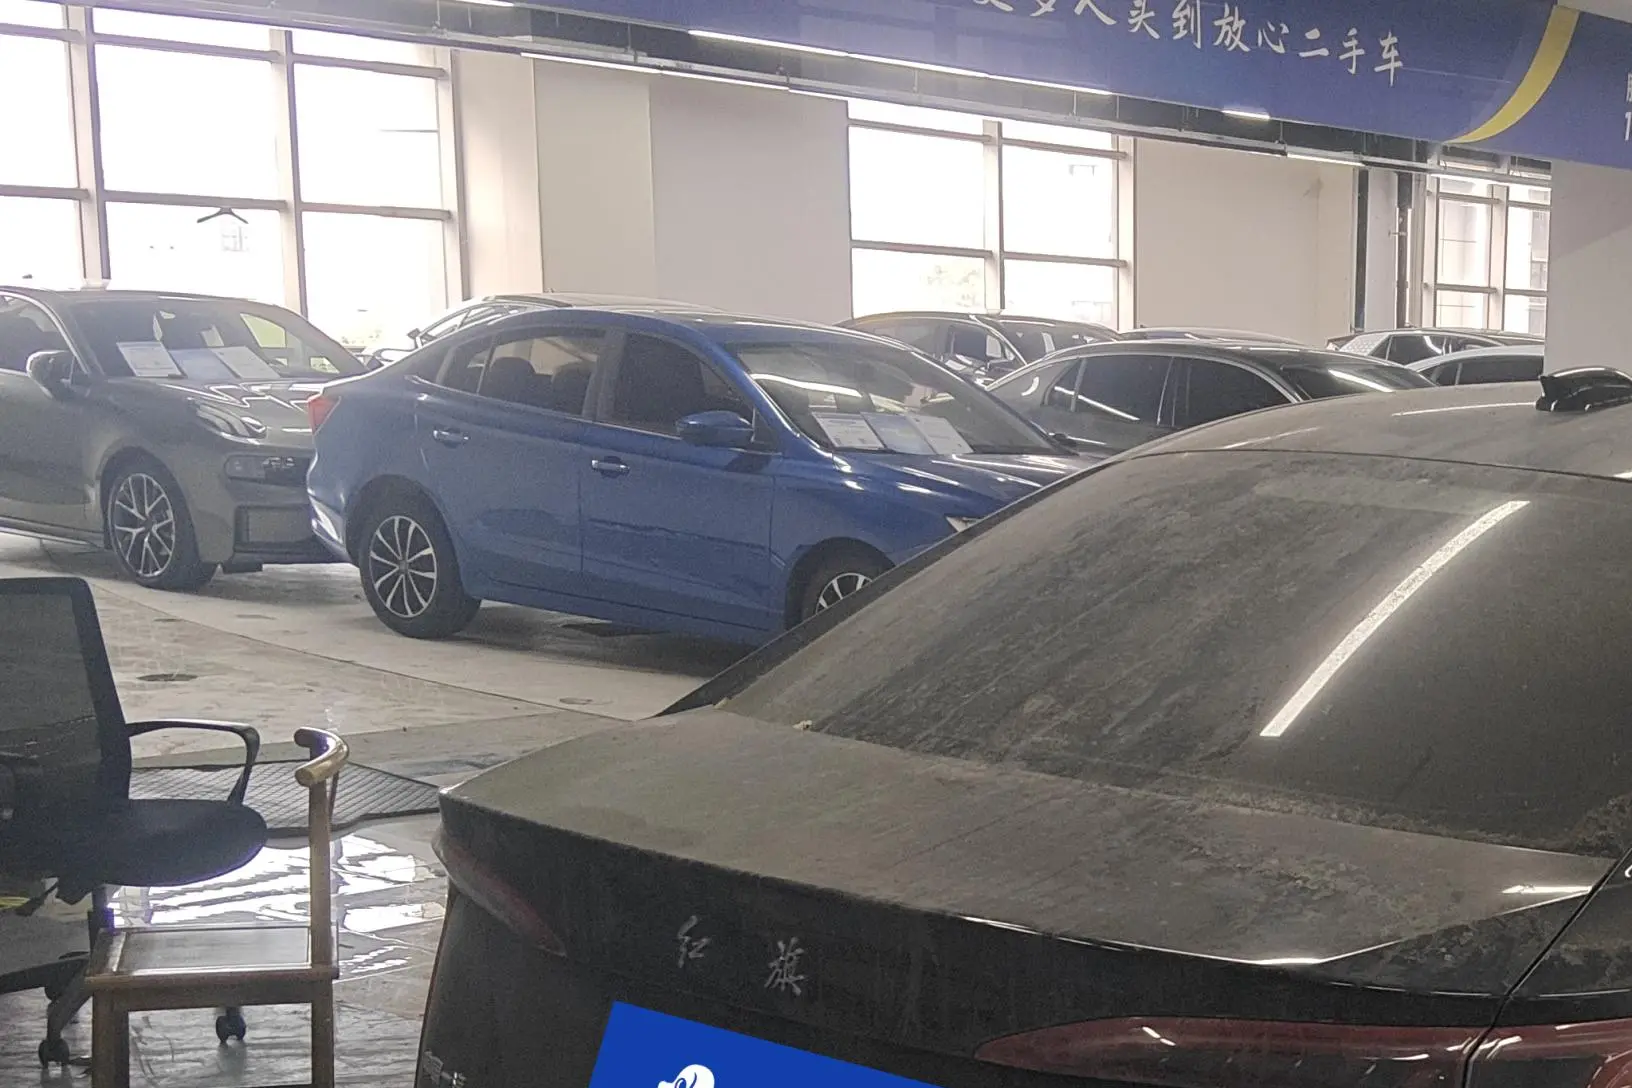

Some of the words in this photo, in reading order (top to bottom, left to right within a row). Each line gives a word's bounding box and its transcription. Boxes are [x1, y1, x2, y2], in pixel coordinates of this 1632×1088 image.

[973, 0, 1402, 87] 人买到放心二手车
[678, 915, 806, 996] 红旗
